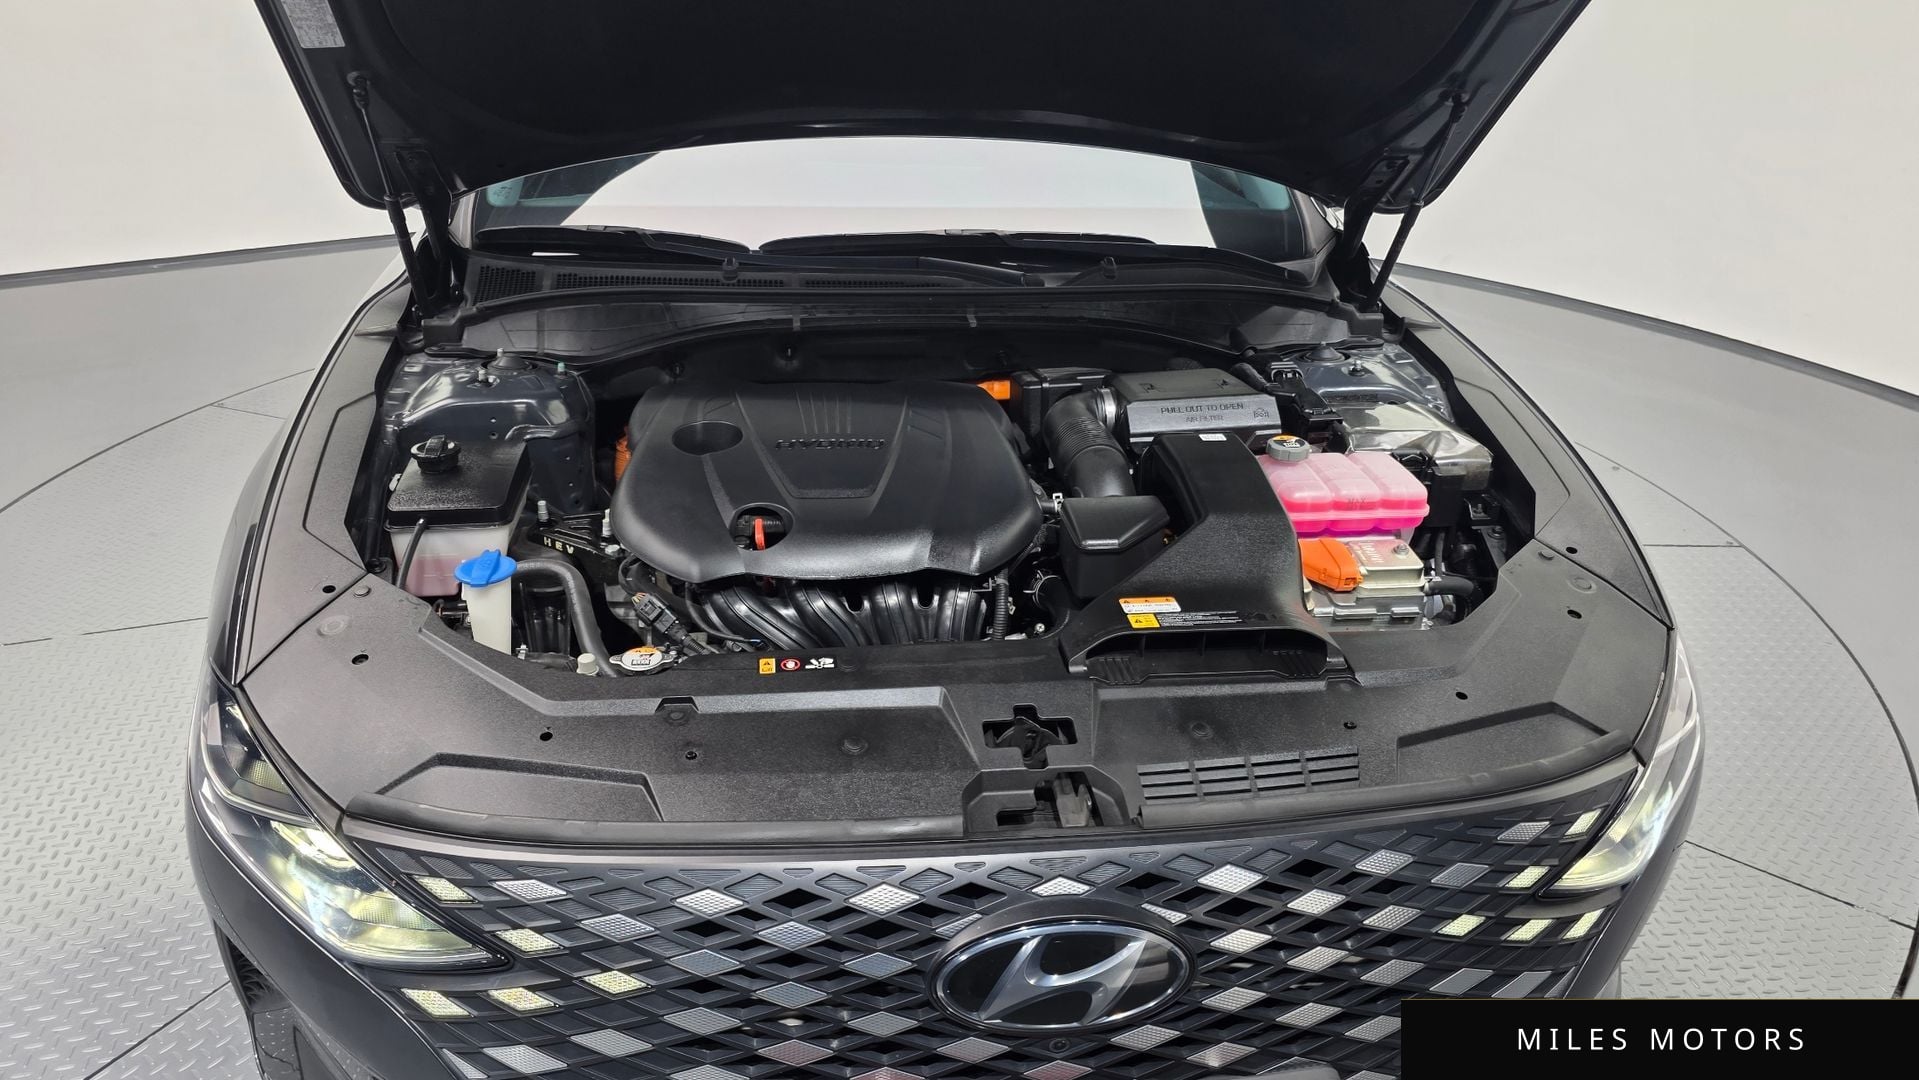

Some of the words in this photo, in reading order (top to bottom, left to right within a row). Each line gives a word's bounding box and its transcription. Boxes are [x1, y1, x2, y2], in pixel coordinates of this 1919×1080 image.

[1186, 405, 1203, 413] OUT
[1207, 404, 1218, 412] TO
[1220, 402, 1244, 410] OPEN
[543, 536, 575, 554] HEV
